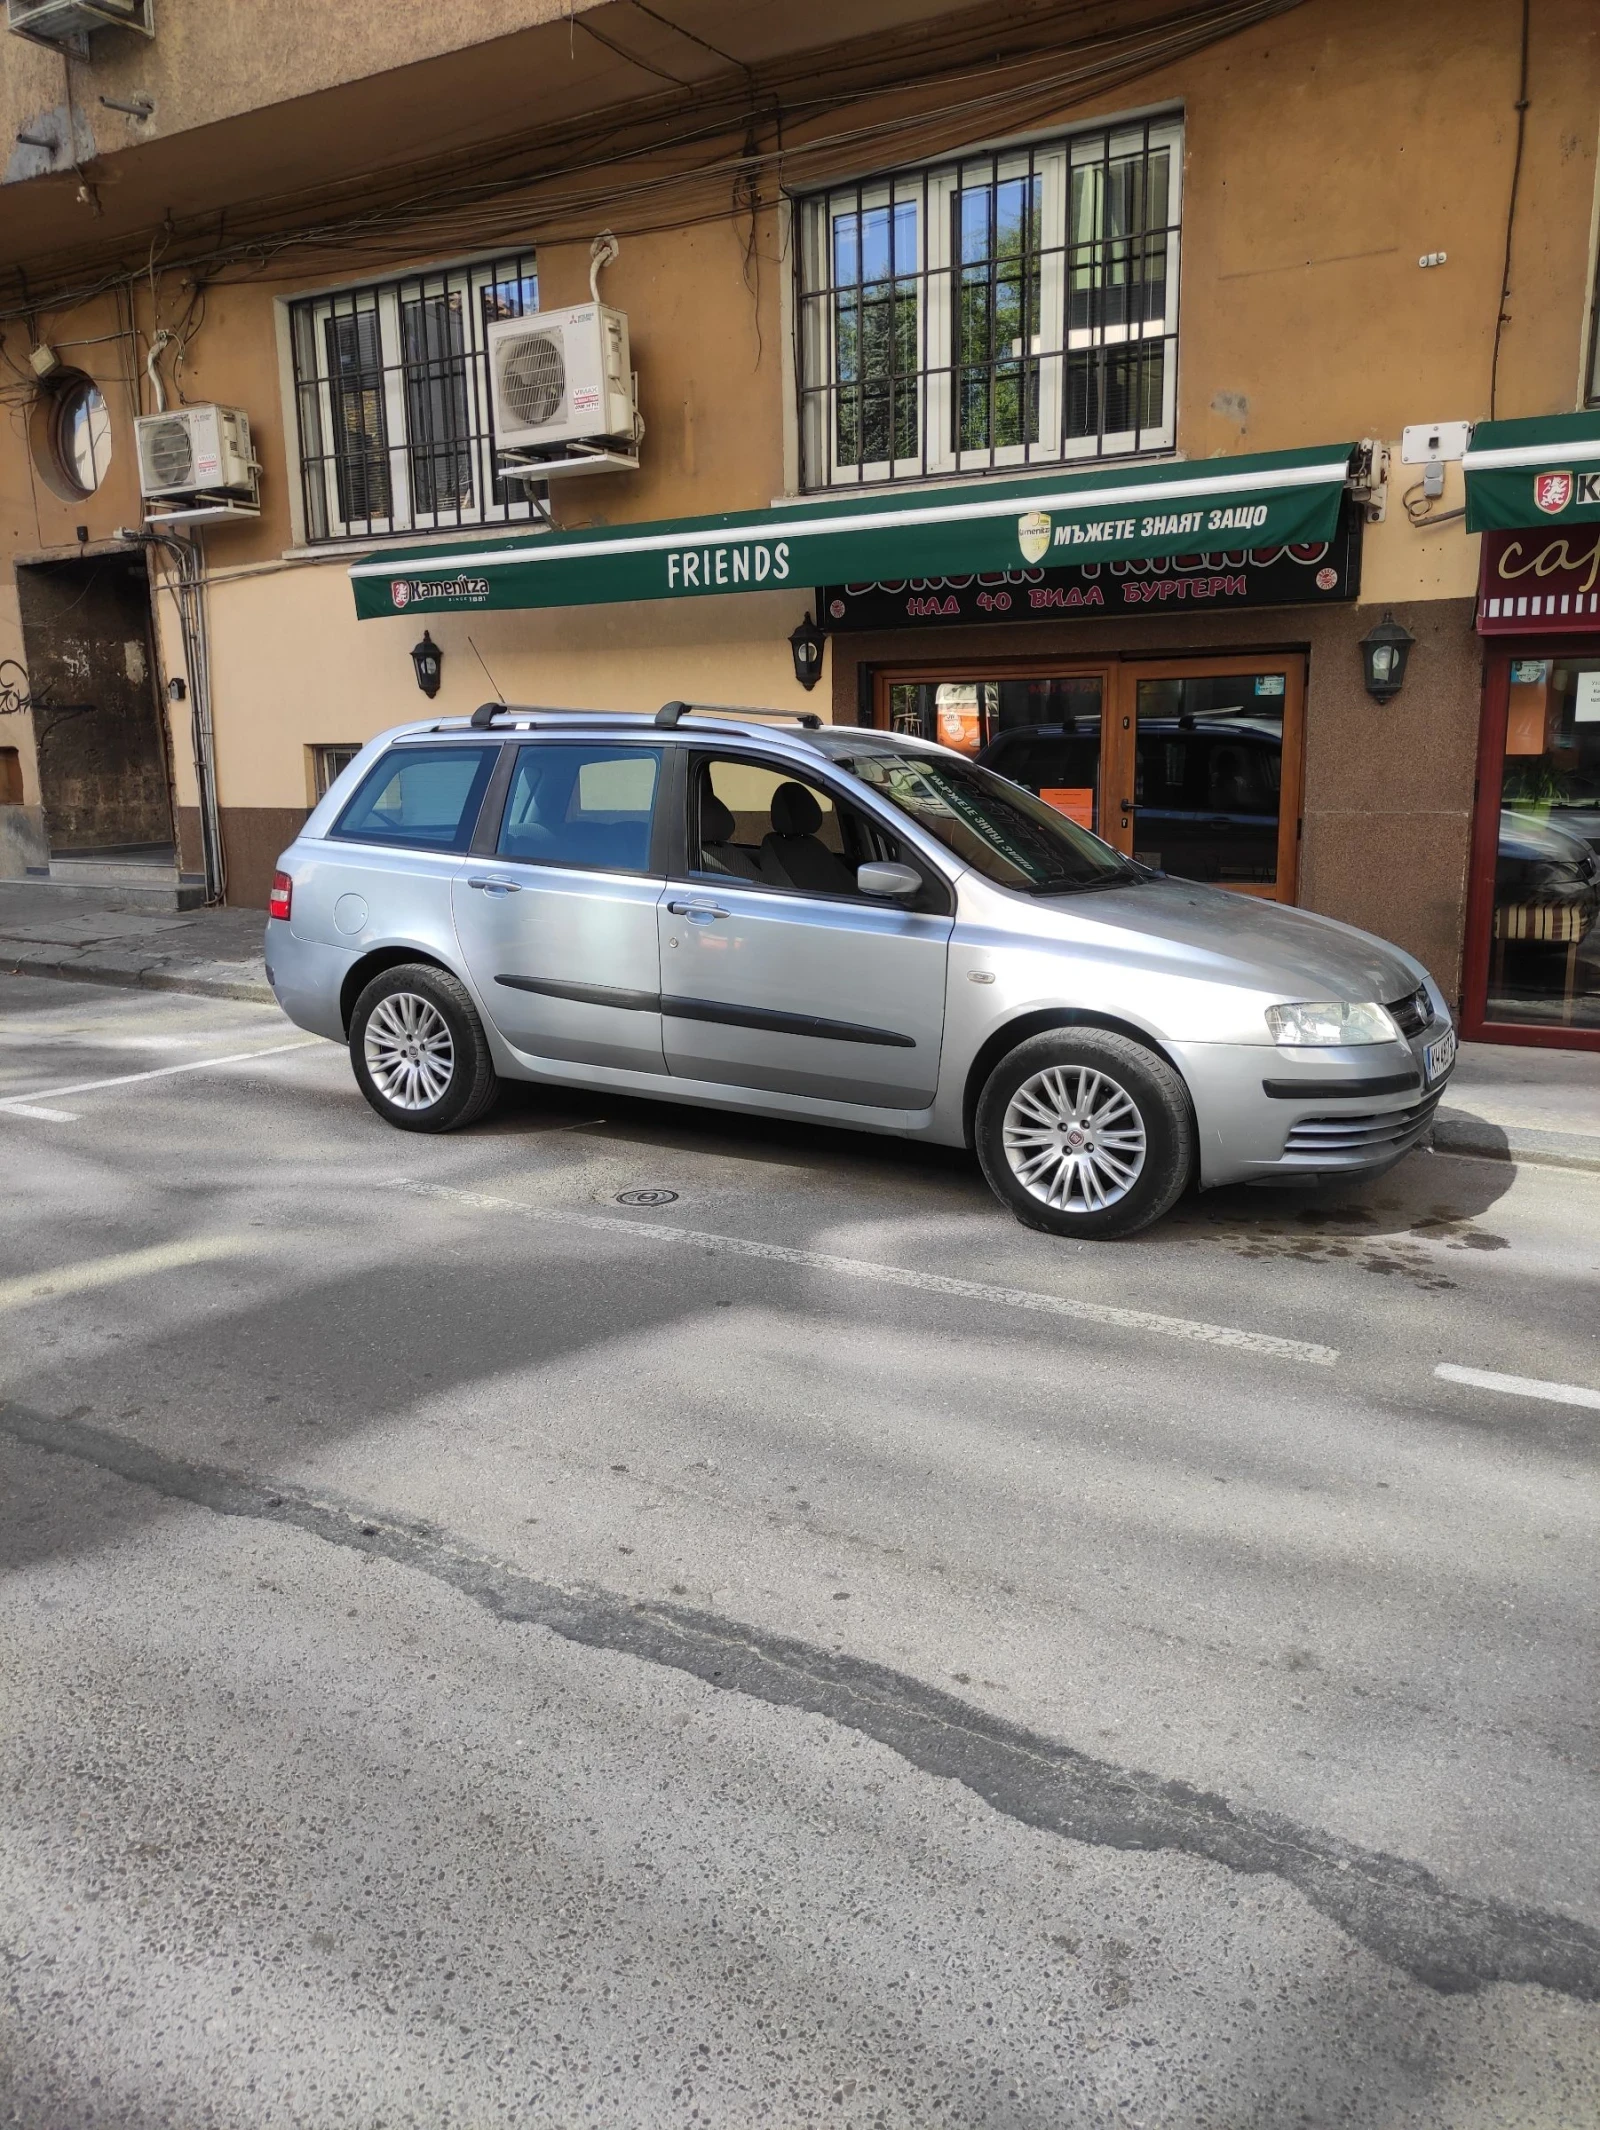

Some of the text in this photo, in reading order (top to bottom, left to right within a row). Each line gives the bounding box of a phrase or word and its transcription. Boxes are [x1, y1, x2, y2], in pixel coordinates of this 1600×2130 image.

[575, 387, 597, 395] VIMAX
[1053, 505, 1268, 546] МЪЖЕТЕ ЗНАЯТ ЗАЩО
[668, 542, 789, 588] FRIENDS
[409, 574, 489, 601] Kamenitza
[907, 574, 1247, 615] НАД 40 ВИДА БУРГЕРИ
